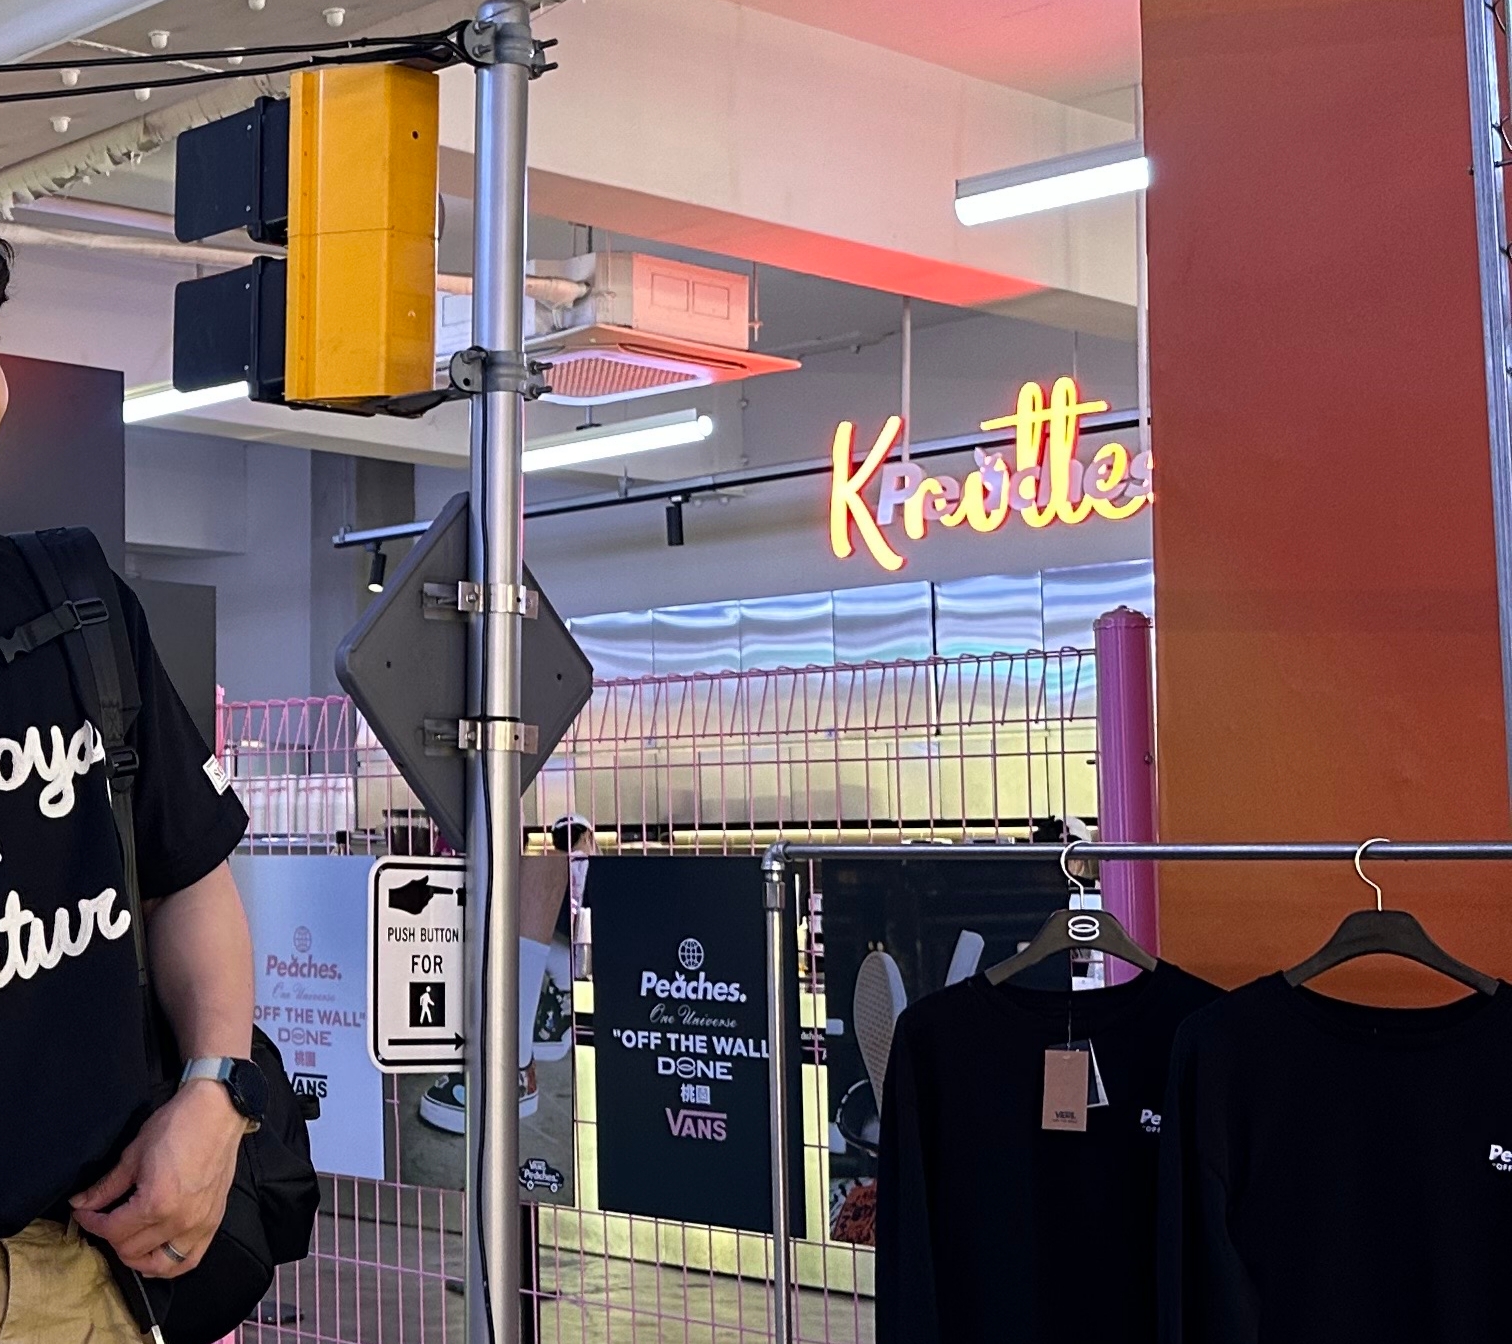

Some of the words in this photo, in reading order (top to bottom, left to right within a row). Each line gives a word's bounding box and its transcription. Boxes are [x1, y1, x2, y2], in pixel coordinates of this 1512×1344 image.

[387, 927, 415, 943] PUSH
[420, 928, 460, 944] BUTTON
[410, 954, 444, 975] FOR
[287, 1006, 314, 1024] THE
[670, 1033, 707, 1053] THE
[712, 1035, 771, 1058] WALL
[664, 1106, 728, 1142] VANS
